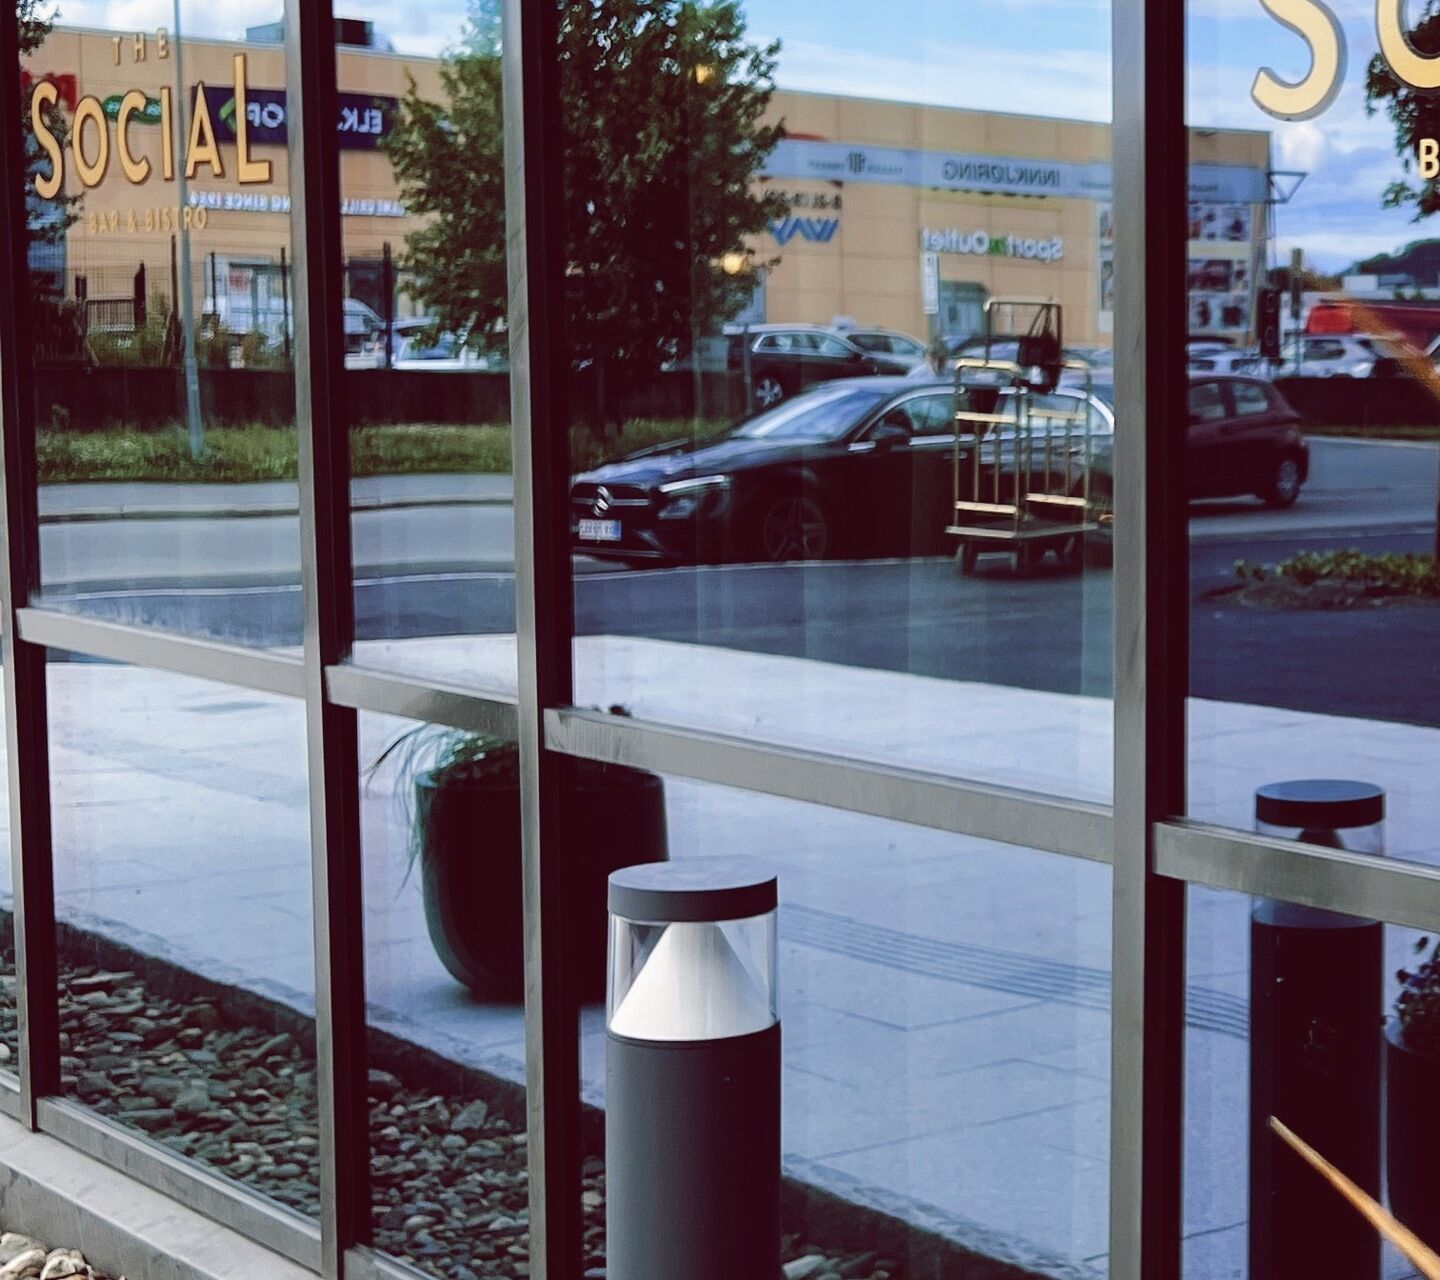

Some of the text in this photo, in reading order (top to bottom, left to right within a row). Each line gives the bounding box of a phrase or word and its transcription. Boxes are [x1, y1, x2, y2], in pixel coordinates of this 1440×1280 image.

[112, 26, 170, 66] THE
[31, 53, 272, 198] SOCIAL
[87, 206, 209, 234] BAR & BISTRO
